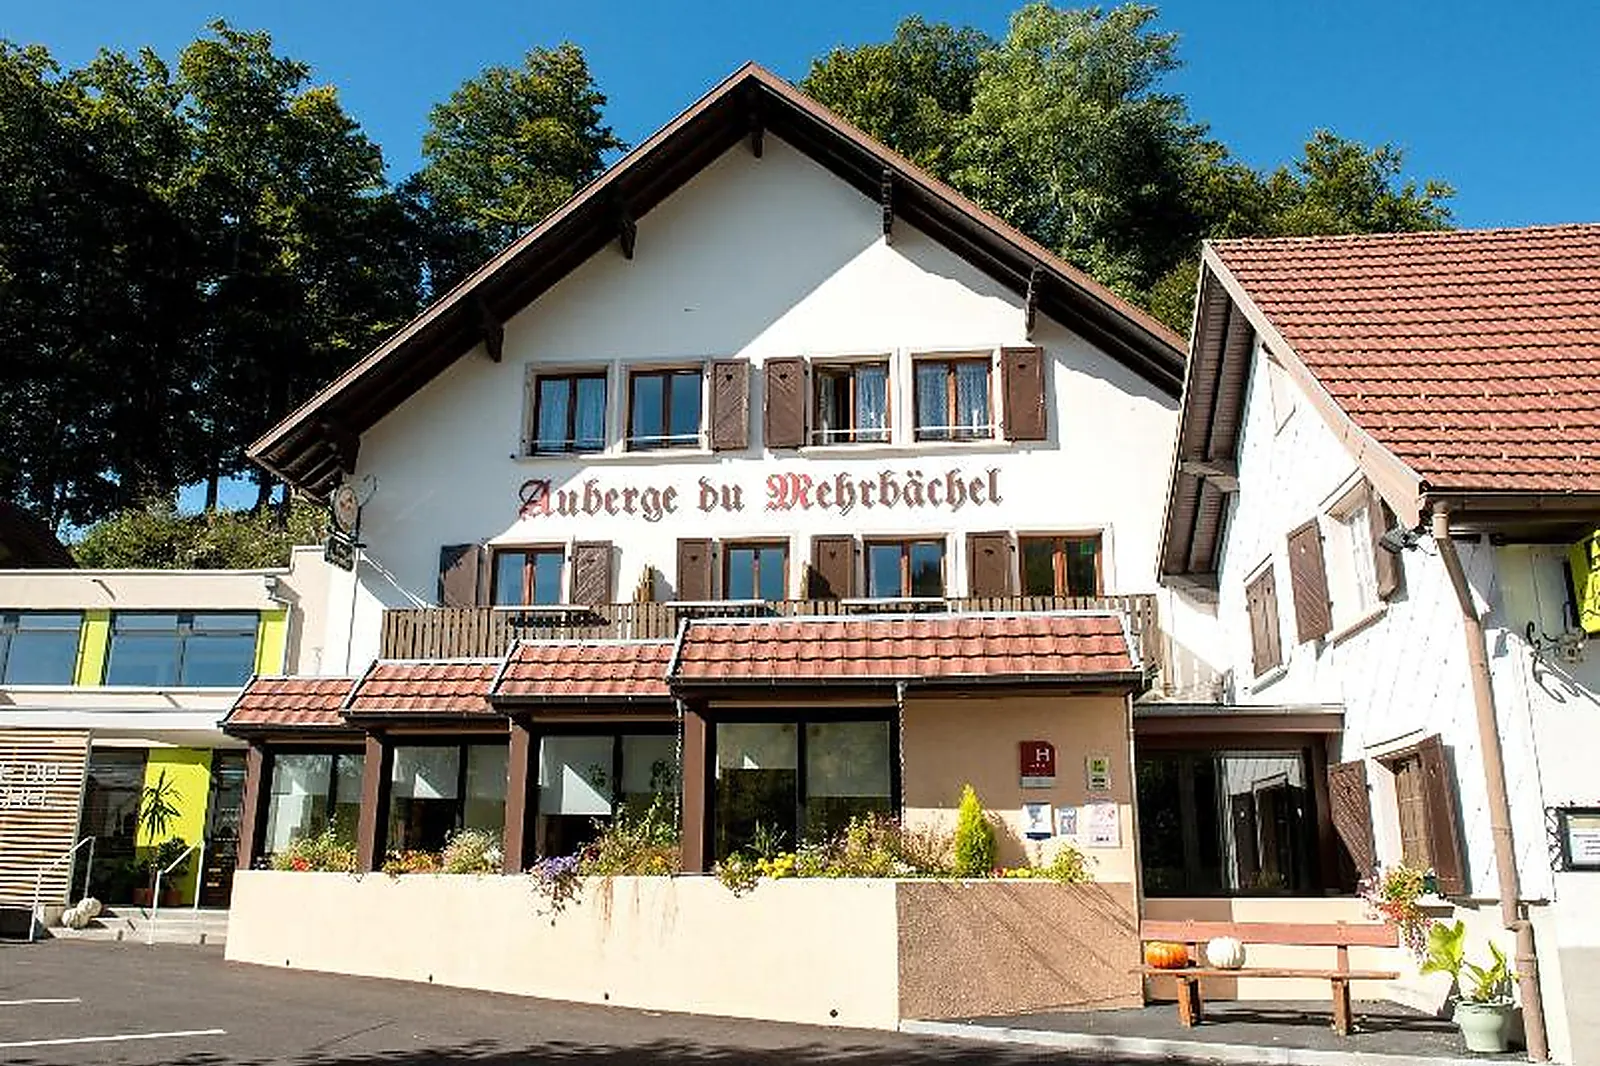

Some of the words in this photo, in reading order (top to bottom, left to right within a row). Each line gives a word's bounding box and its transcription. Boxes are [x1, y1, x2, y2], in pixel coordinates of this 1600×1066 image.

[519, 479, 678, 523] Auberge
[698, 476, 745, 513] du
[764, 467, 1003, 517] Mehrbächel
[1036, 748, 1050, 762] H
